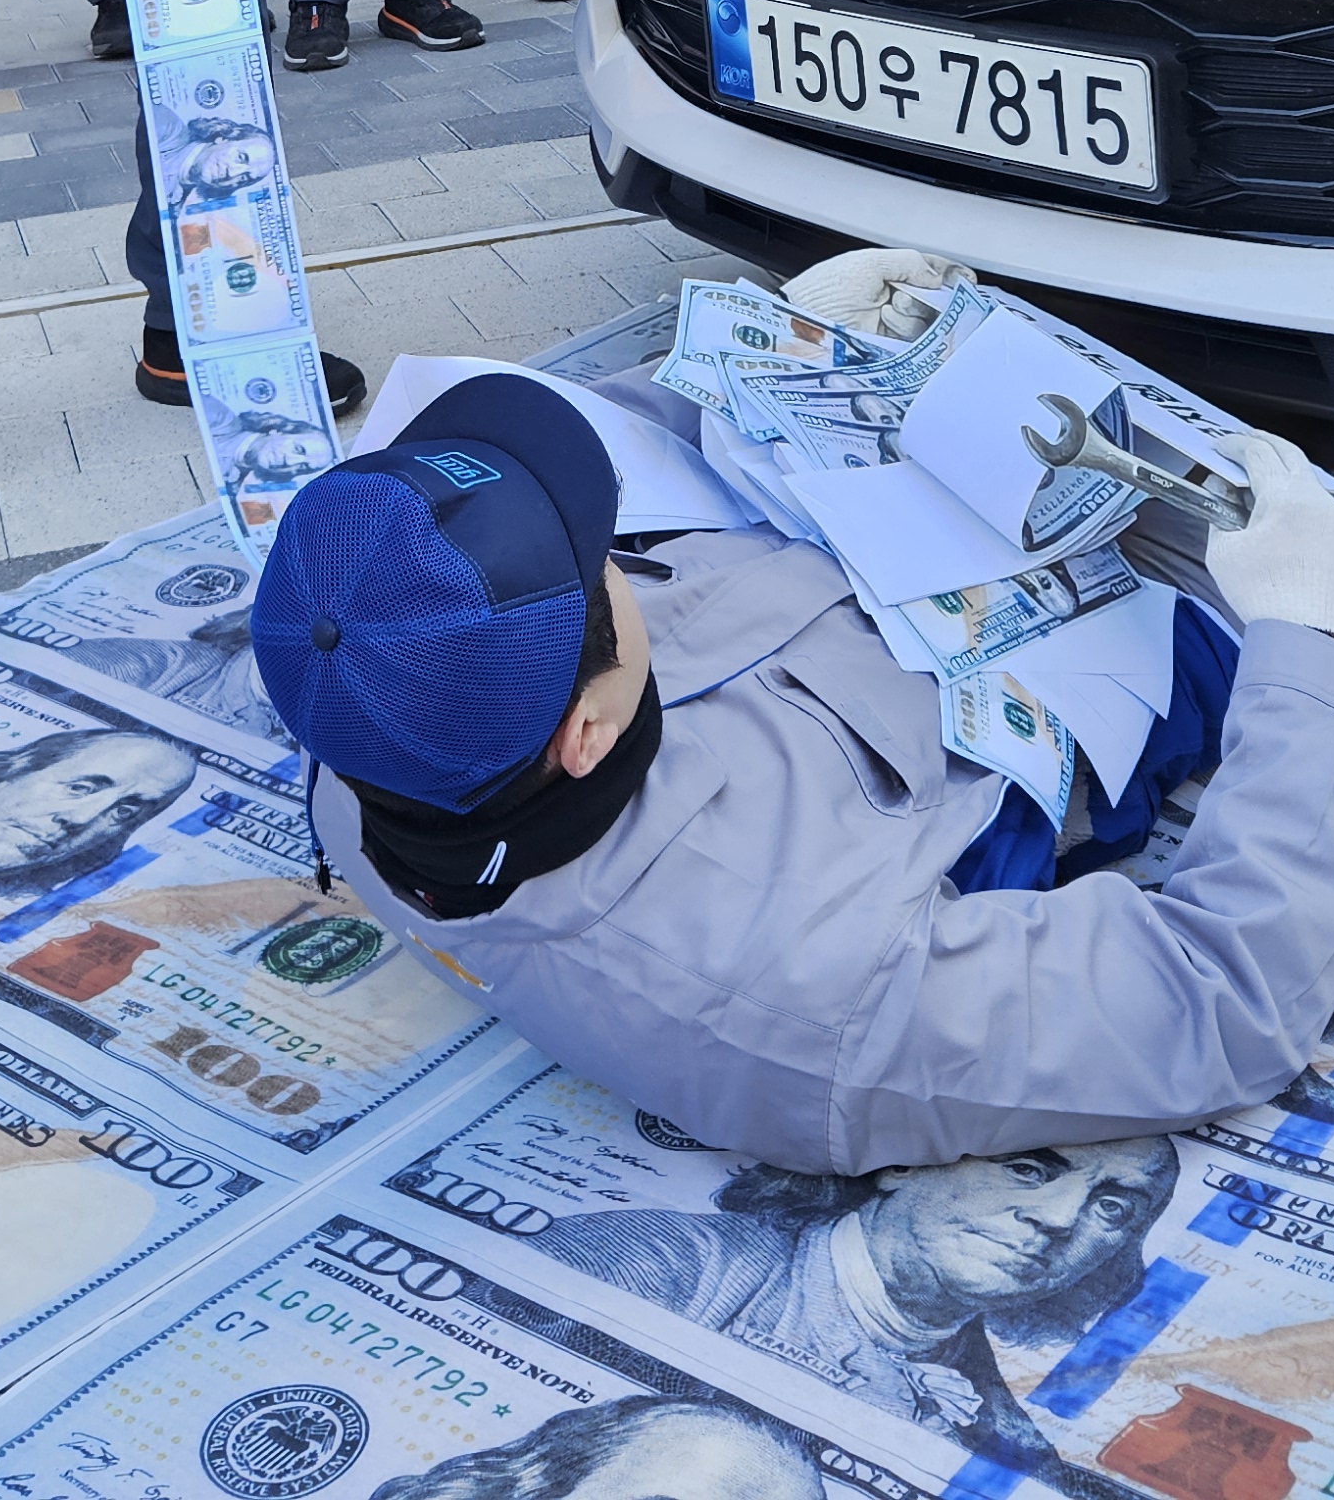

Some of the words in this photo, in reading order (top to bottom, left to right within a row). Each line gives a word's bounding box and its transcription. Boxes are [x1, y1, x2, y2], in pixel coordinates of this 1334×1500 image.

[720, 64, 750, 89] KOR
[757, 15, 920, 120] 150우
[939, 50, 1130, 166] 7815
[141, 963, 323, 1063] LG04727792
[143, 1022, 321, 1116] 100
[79, 1120, 213, 1190] 100
[419, 1170, 555, 1237] 100
[313, 1229, 467, 1302] 100
[1254, 1250, 1284, 1266] FOR
[1286, 1260, 1314, 1276] ALL
[1293, 1253, 1329, 1272] THIS
[214, 1310, 270, 1342] G7
[255, 1279, 490, 1408] LG04727792
[303, 1256, 410, 1315] FEDERAL
[404, 1300, 526, 1372] RESERVE
[521, 1361, 596, 1404] NOTE
[749, 1331, 843, 1381] FRANKLIN
[208, 1398, 257, 1461] FEDERAL
[272, 1388, 328, 1407] UNITED
[328, 1393, 362, 1442] STATES
[210, 1457, 270, 1498] RESERVE
[278, 1455, 348, 1496] SYSTEM
[820, 1449, 909, 1500] ONE
